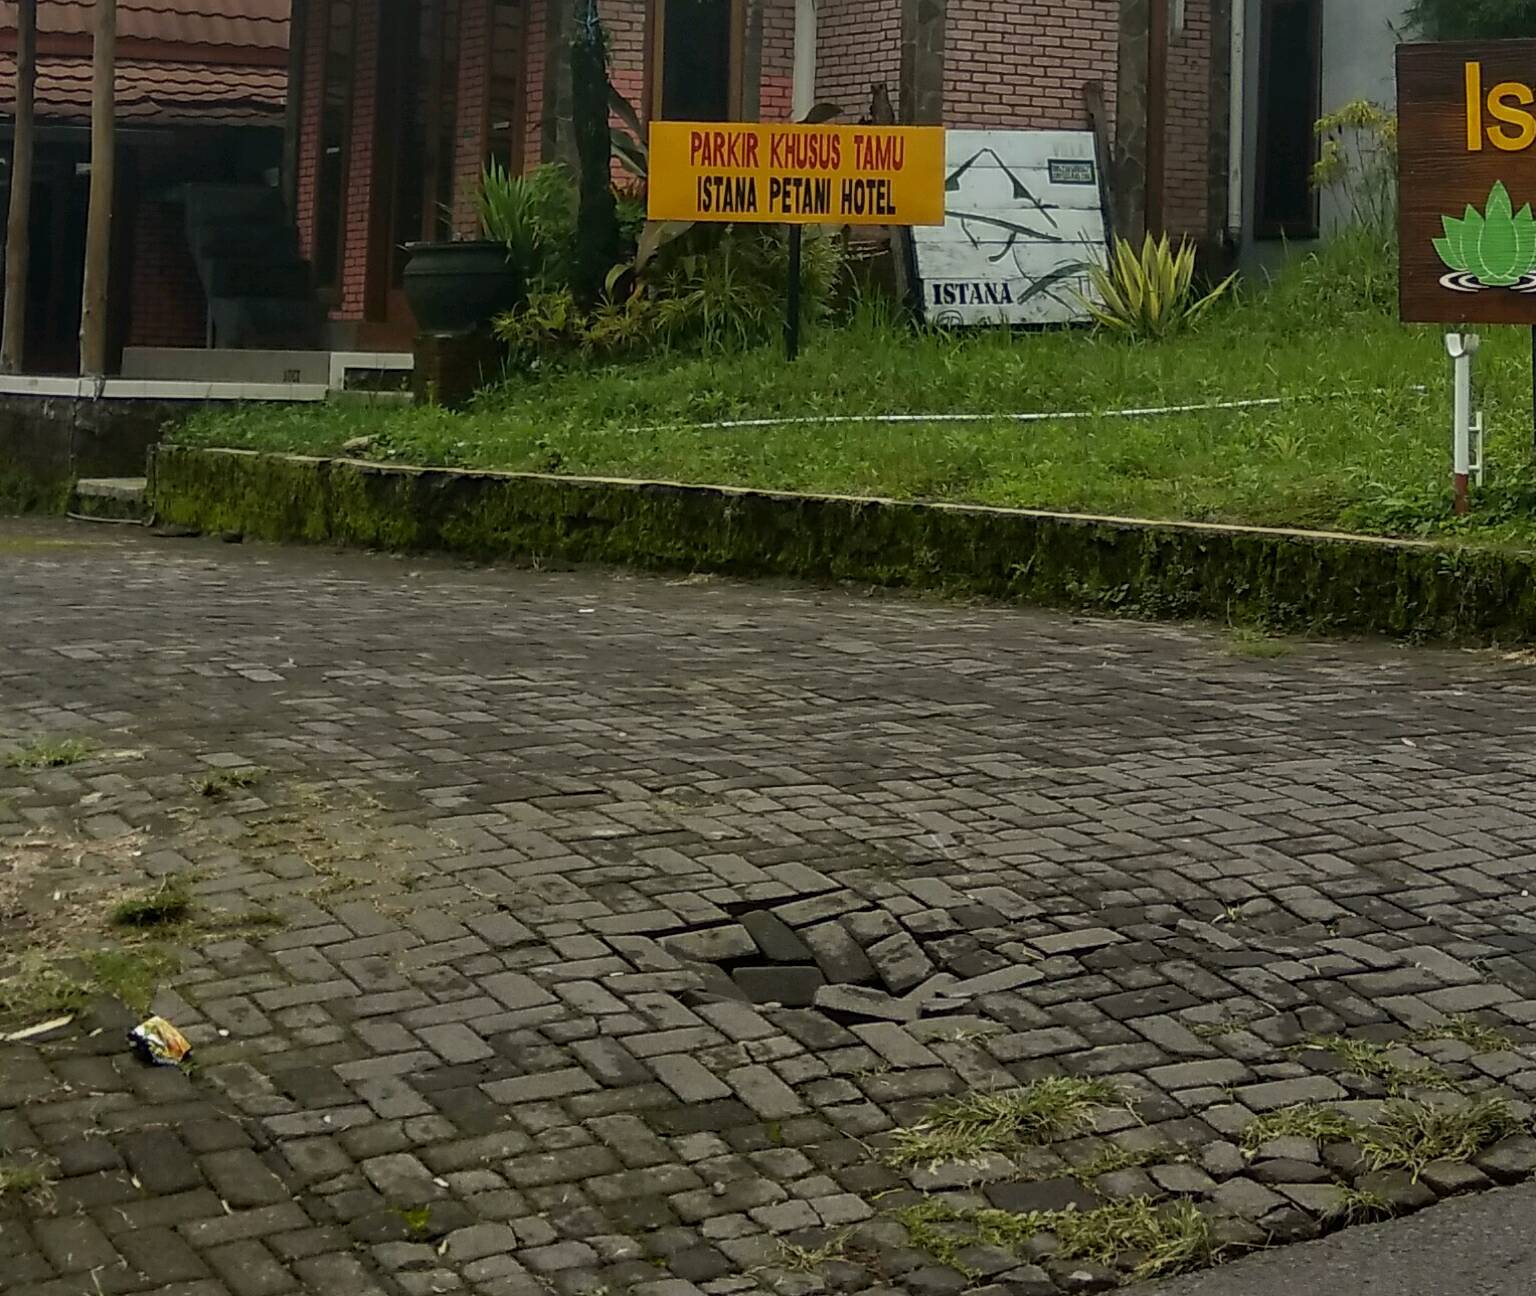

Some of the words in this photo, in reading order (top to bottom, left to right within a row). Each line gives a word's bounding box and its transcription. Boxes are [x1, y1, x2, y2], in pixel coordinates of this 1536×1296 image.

[690, 131, 759, 169] PARKIR
[769, 132, 841, 170] KHUSUS
[854, 134, 905, 172] TAMU
[697, 175, 757, 213] ISTANA
[769, 177, 832, 215] PETANI
[840, 178, 897, 216] HOTEL
[932, 282, 1014, 305] ISTANA
